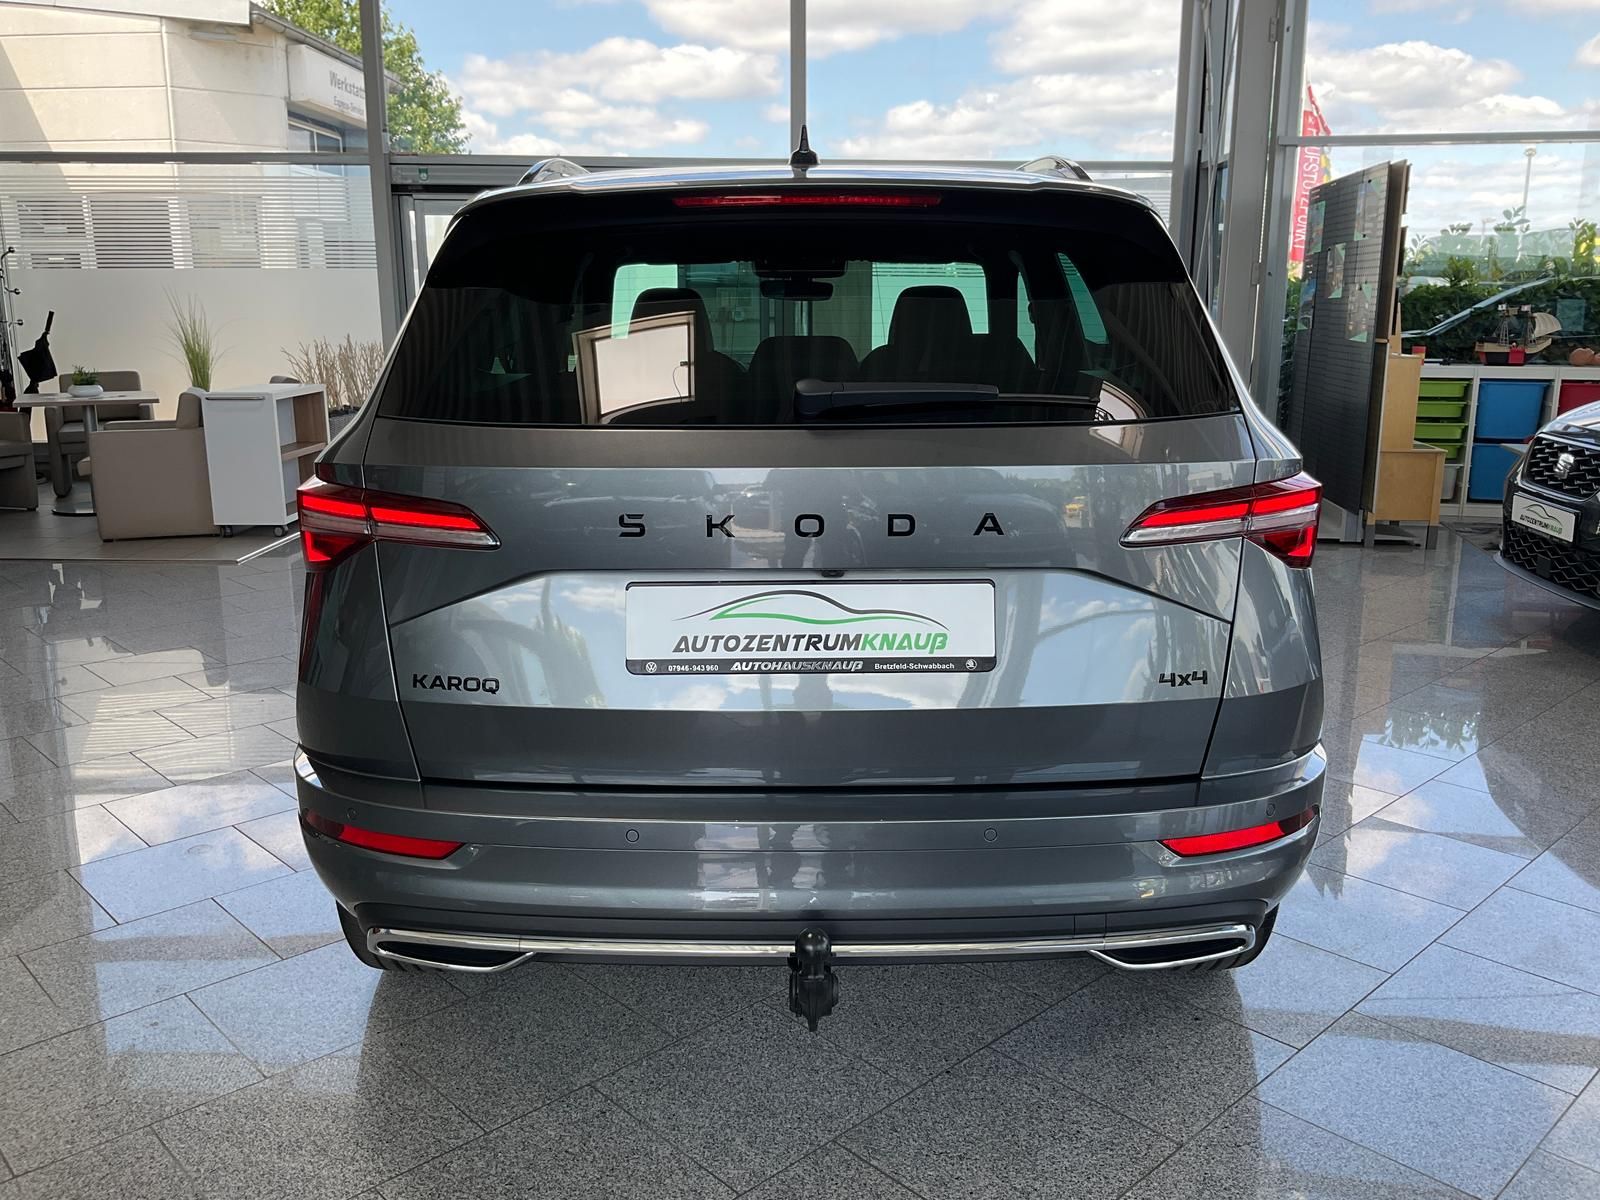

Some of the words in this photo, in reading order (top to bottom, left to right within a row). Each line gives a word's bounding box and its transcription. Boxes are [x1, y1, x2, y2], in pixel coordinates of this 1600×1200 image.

[874, 662, 955, 671] Bretzfeld-Schwabbach
[412, 673, 500, 695] KAROQ
[1159, 670, 1208, 687] 4x4
